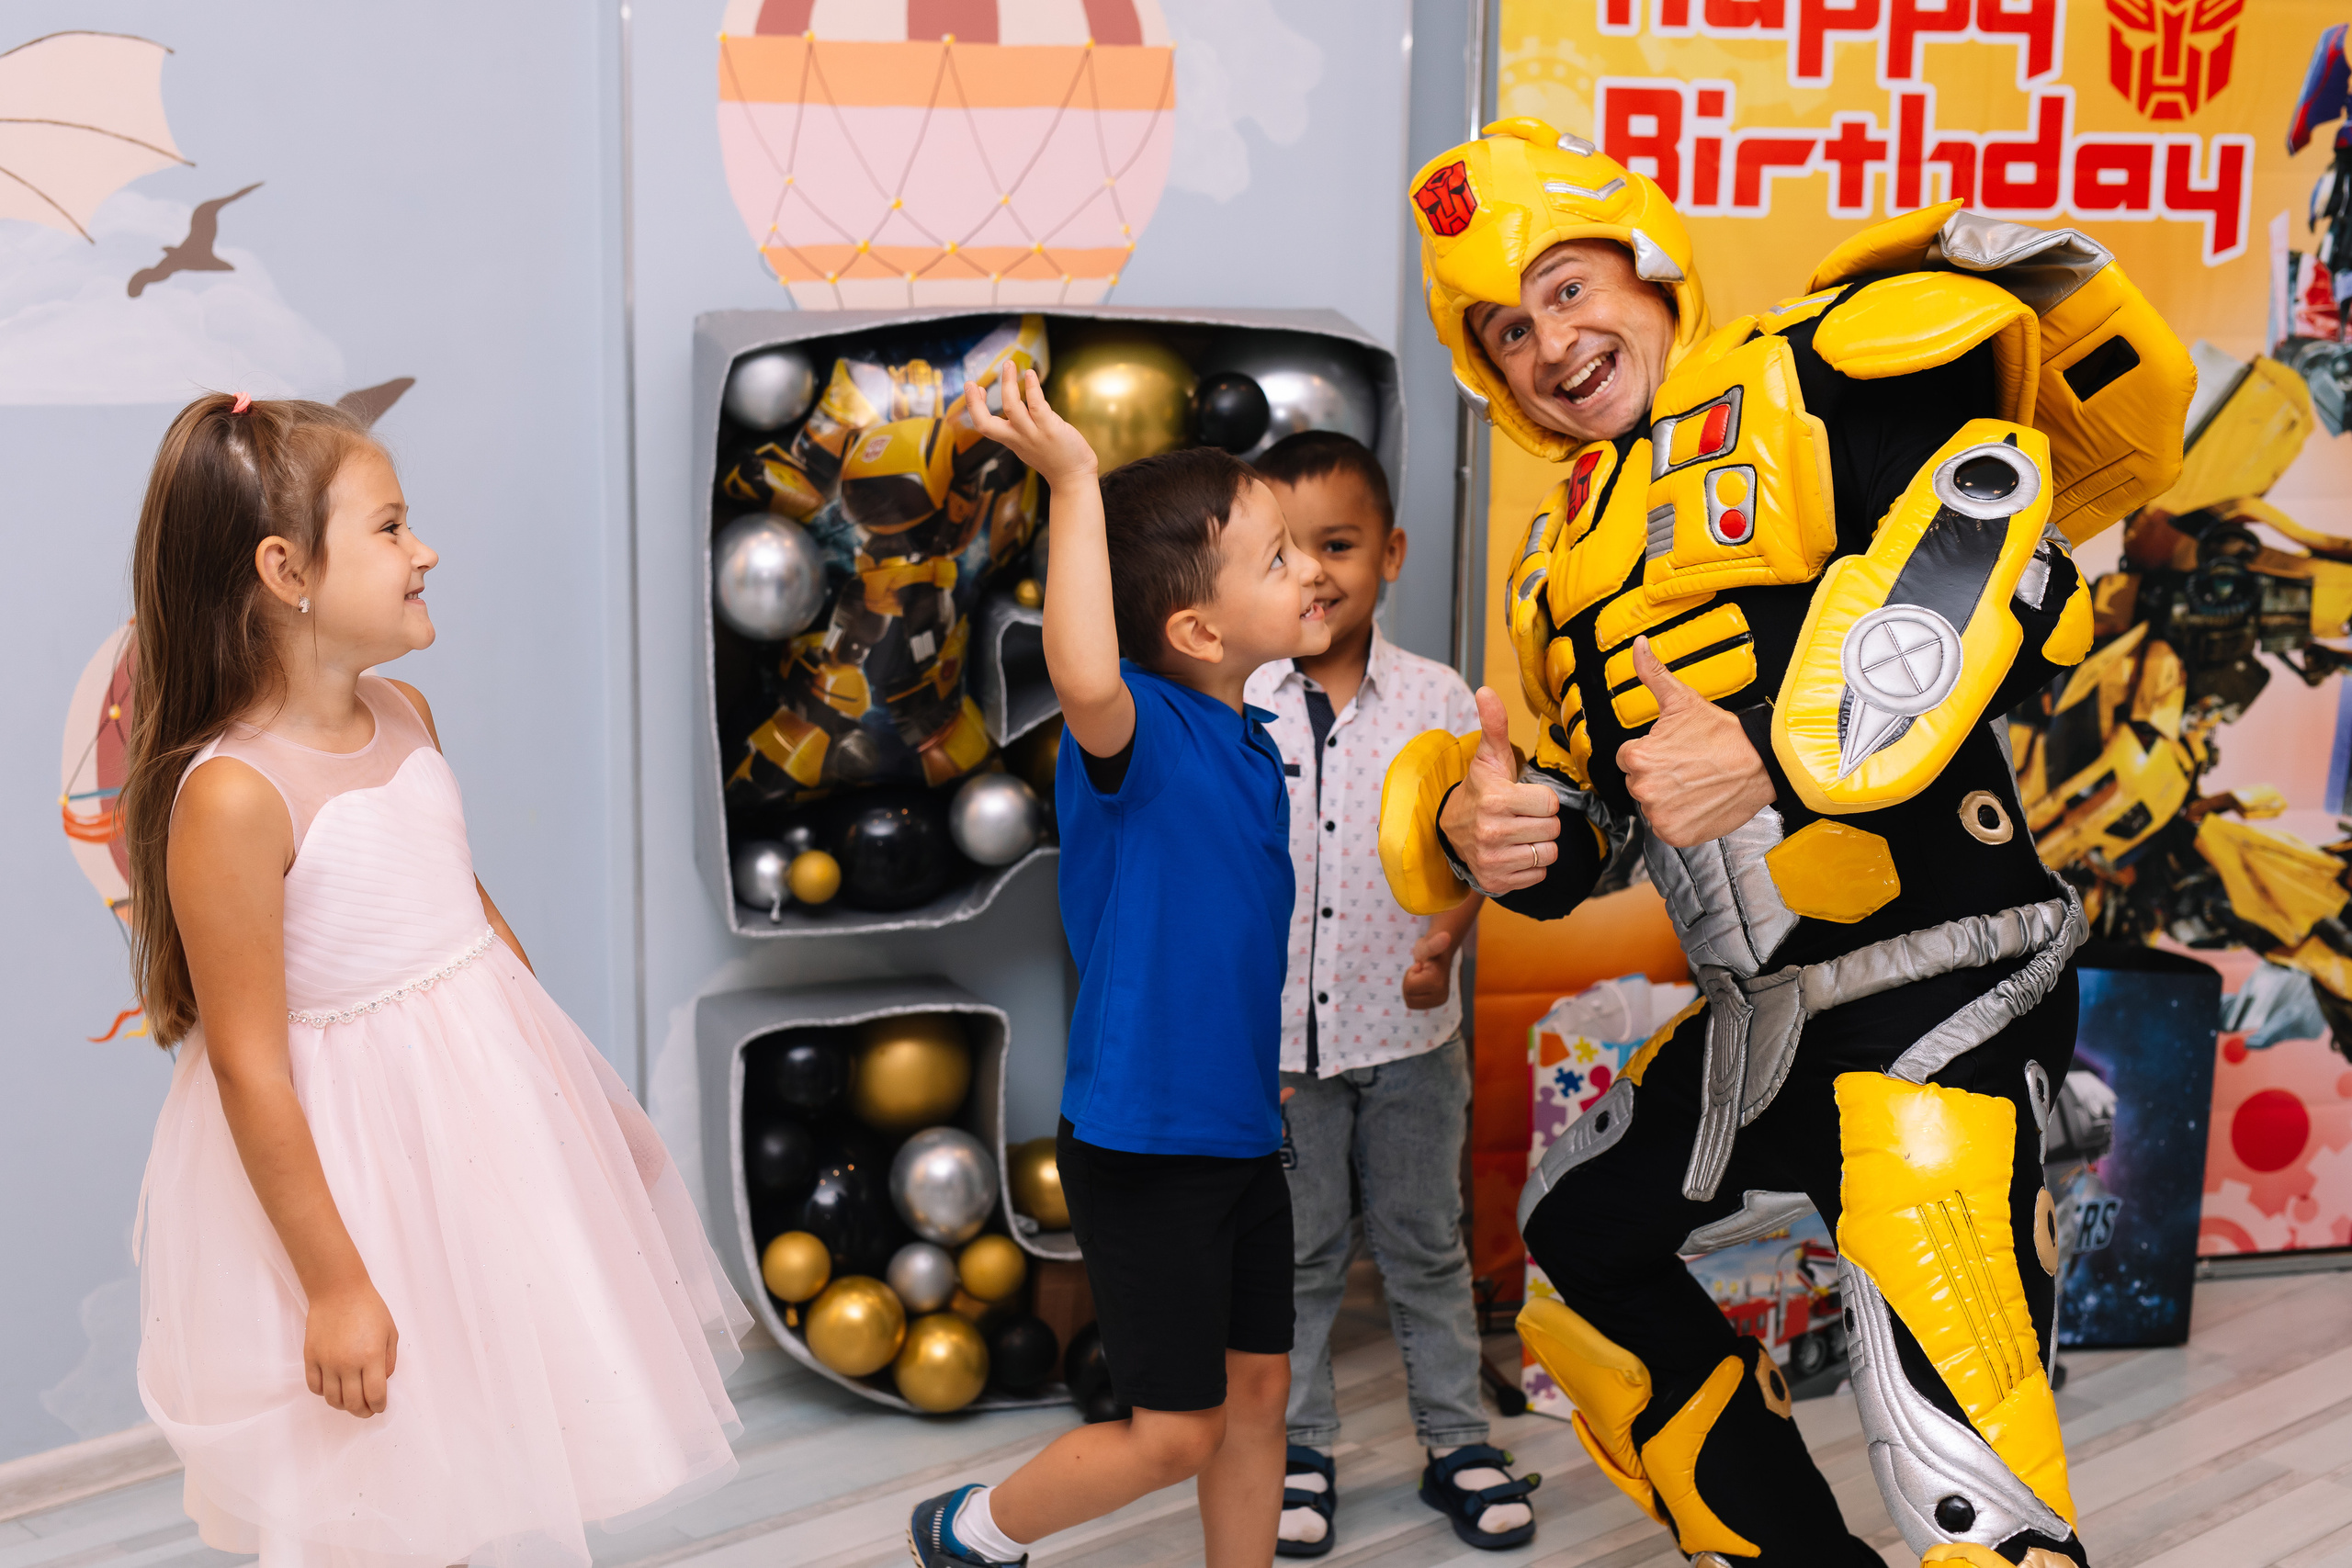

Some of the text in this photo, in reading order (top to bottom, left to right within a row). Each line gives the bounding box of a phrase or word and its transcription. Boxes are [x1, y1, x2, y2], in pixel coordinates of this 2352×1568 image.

[1604, 0, 2058, 79] ppy
[1602, 86, 2245, 255] Birthday
[2075, 1201, 2119, 1248] RS
